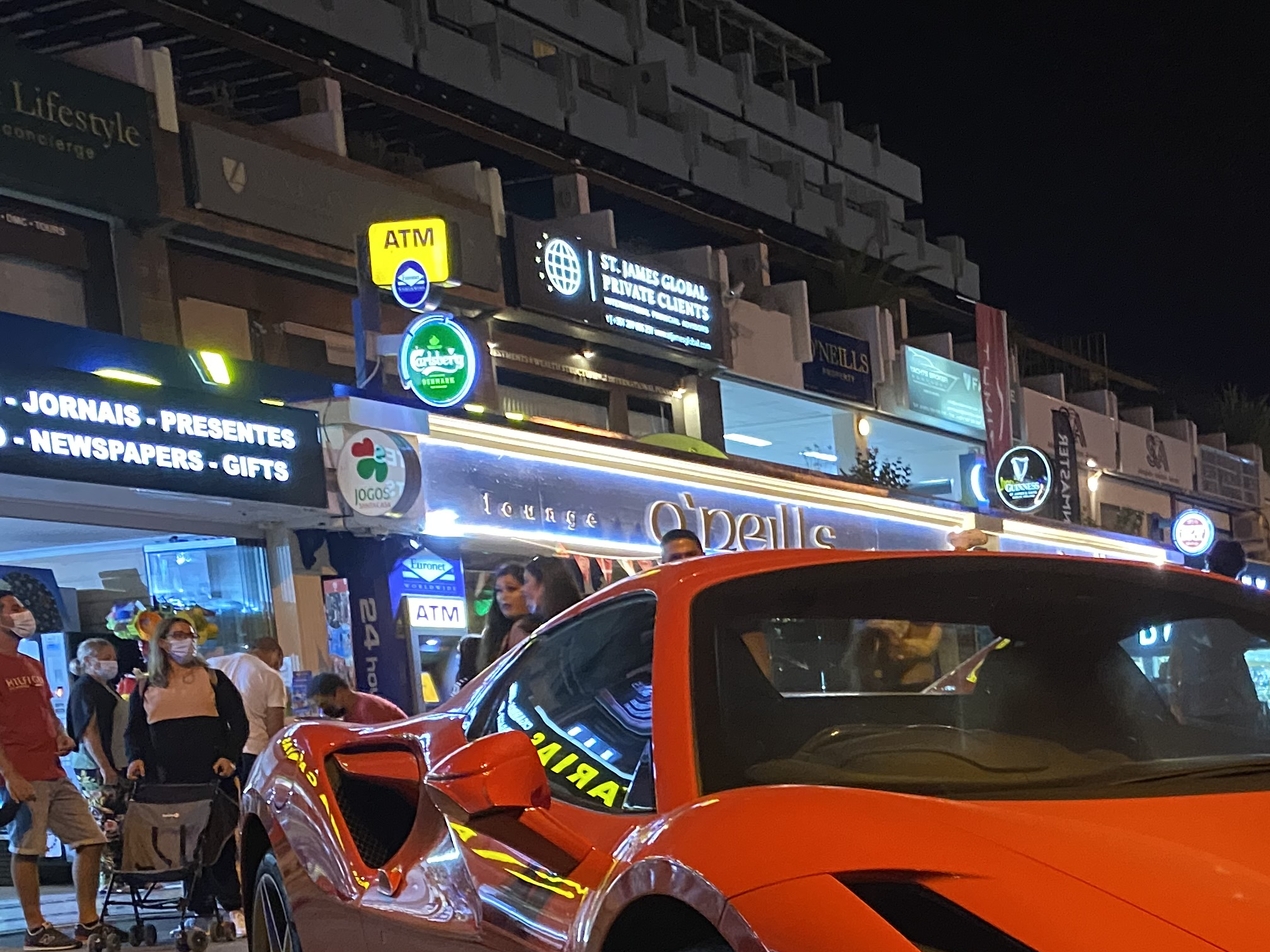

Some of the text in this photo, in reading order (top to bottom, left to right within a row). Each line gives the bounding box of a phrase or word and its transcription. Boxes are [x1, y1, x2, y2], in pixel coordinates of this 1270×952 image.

[11, 80, 141, 148] Lifestyle
[2, 123, 96, 160] concierge
[384, 227, 434, 249] ATM
[600, 252, 709, 302] ST. JAMES GLOBAL
[601, 273, 656, 306] PRIVATE
[657, 291, 710, 322] CLIENTS
[409, 347, 465, 375] Carlsberg
[22, 390, 297, 450] JORNAIS PRESENTES
[30, 429, 290, 482] NEWSPAPERS GIFTS
[354, 487, 391, 506] JOGOS
[1004, 481, 1041, 494] GUINNESS
[482, 492, 599, 531] lounge
[410, 558, 446, 572] Euronet
[403, 583, 457, 592] WORLDWIDE
[359, 597, 381, 651] 24
[416, 604, 460, 623] ATM
